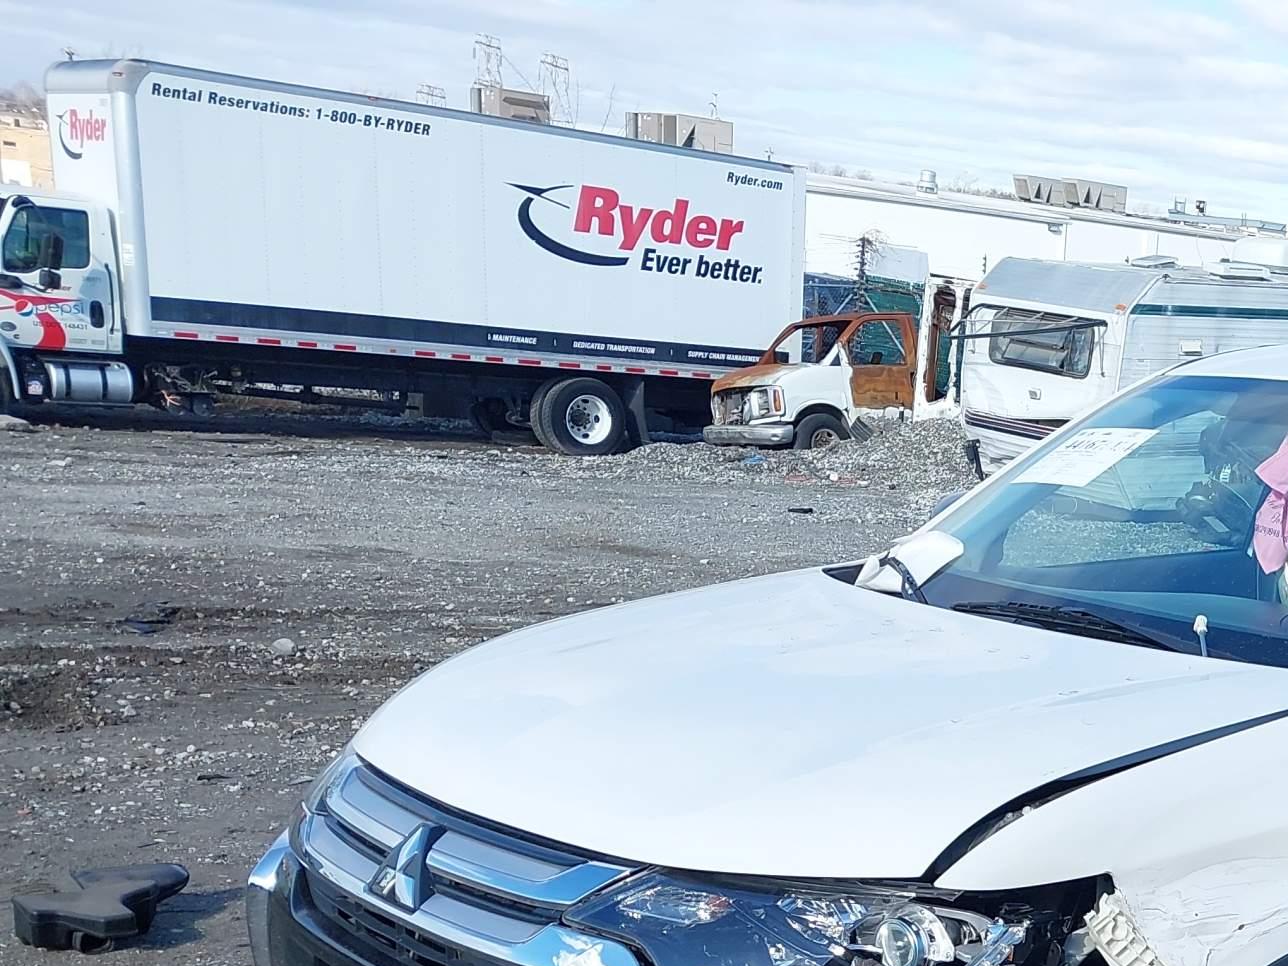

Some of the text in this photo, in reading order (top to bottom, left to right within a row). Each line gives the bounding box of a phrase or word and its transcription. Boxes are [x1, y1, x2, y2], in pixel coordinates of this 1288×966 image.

[151, 82, 432, 137] Rental Reservations: 1-800-BY-RYDER
[68, 108, 107, 149] Ryder
[726, 172, 783, 191] Ryder.com
[574, 184, 744, 251] Ryder
[640, 247, 764, 284] Ever better.
[35, 303, 85, 315] pepsi
[492, 334, 537, 345] MAINTENANCE
[573, 341, 656, 354] DEDICATED TRANSPORTATION
[687, 351, 760, 362] SUPPLY CHAIN MANAGEMEN
